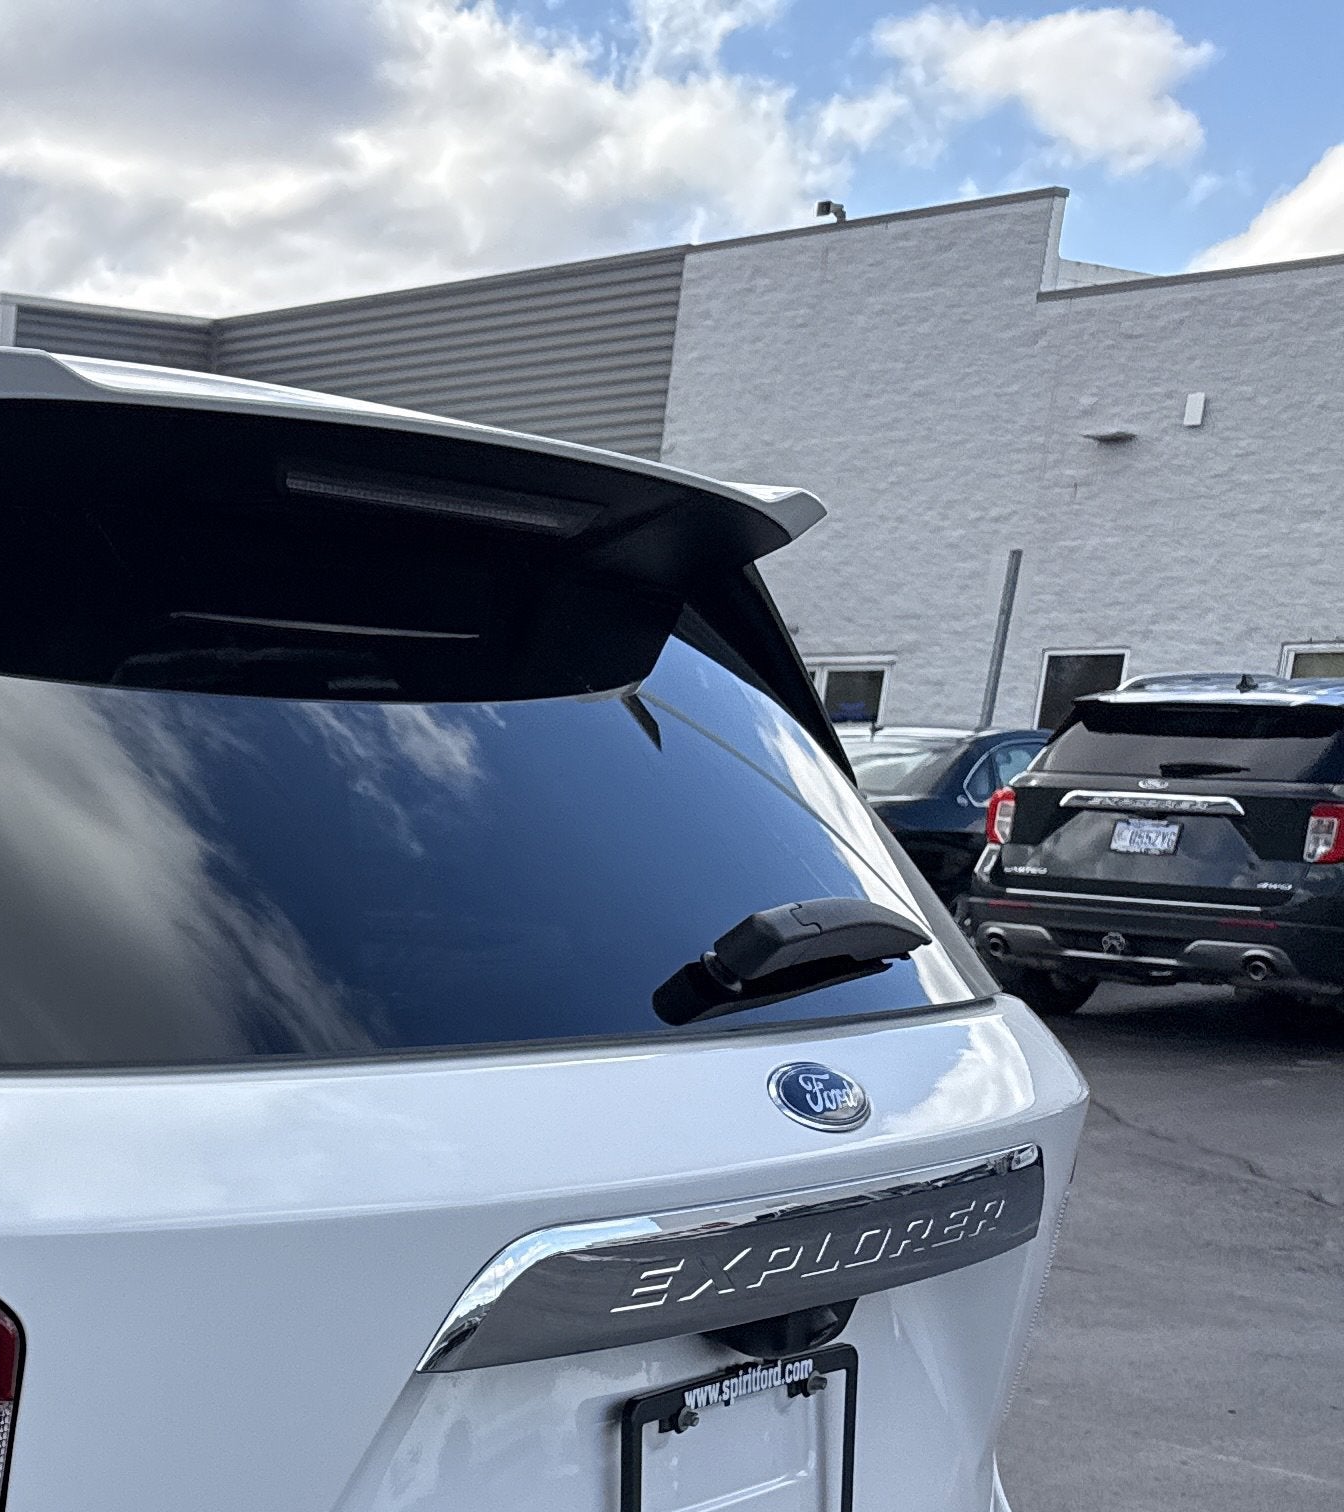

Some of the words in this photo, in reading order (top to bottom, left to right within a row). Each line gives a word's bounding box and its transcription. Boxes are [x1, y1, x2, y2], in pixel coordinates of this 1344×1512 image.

[798, 1073, 858, 1113] Ford
[610, 1199, 1006, 1313] EXPLORER
[684, 1358, 814, 1410] www.spiritford.com
